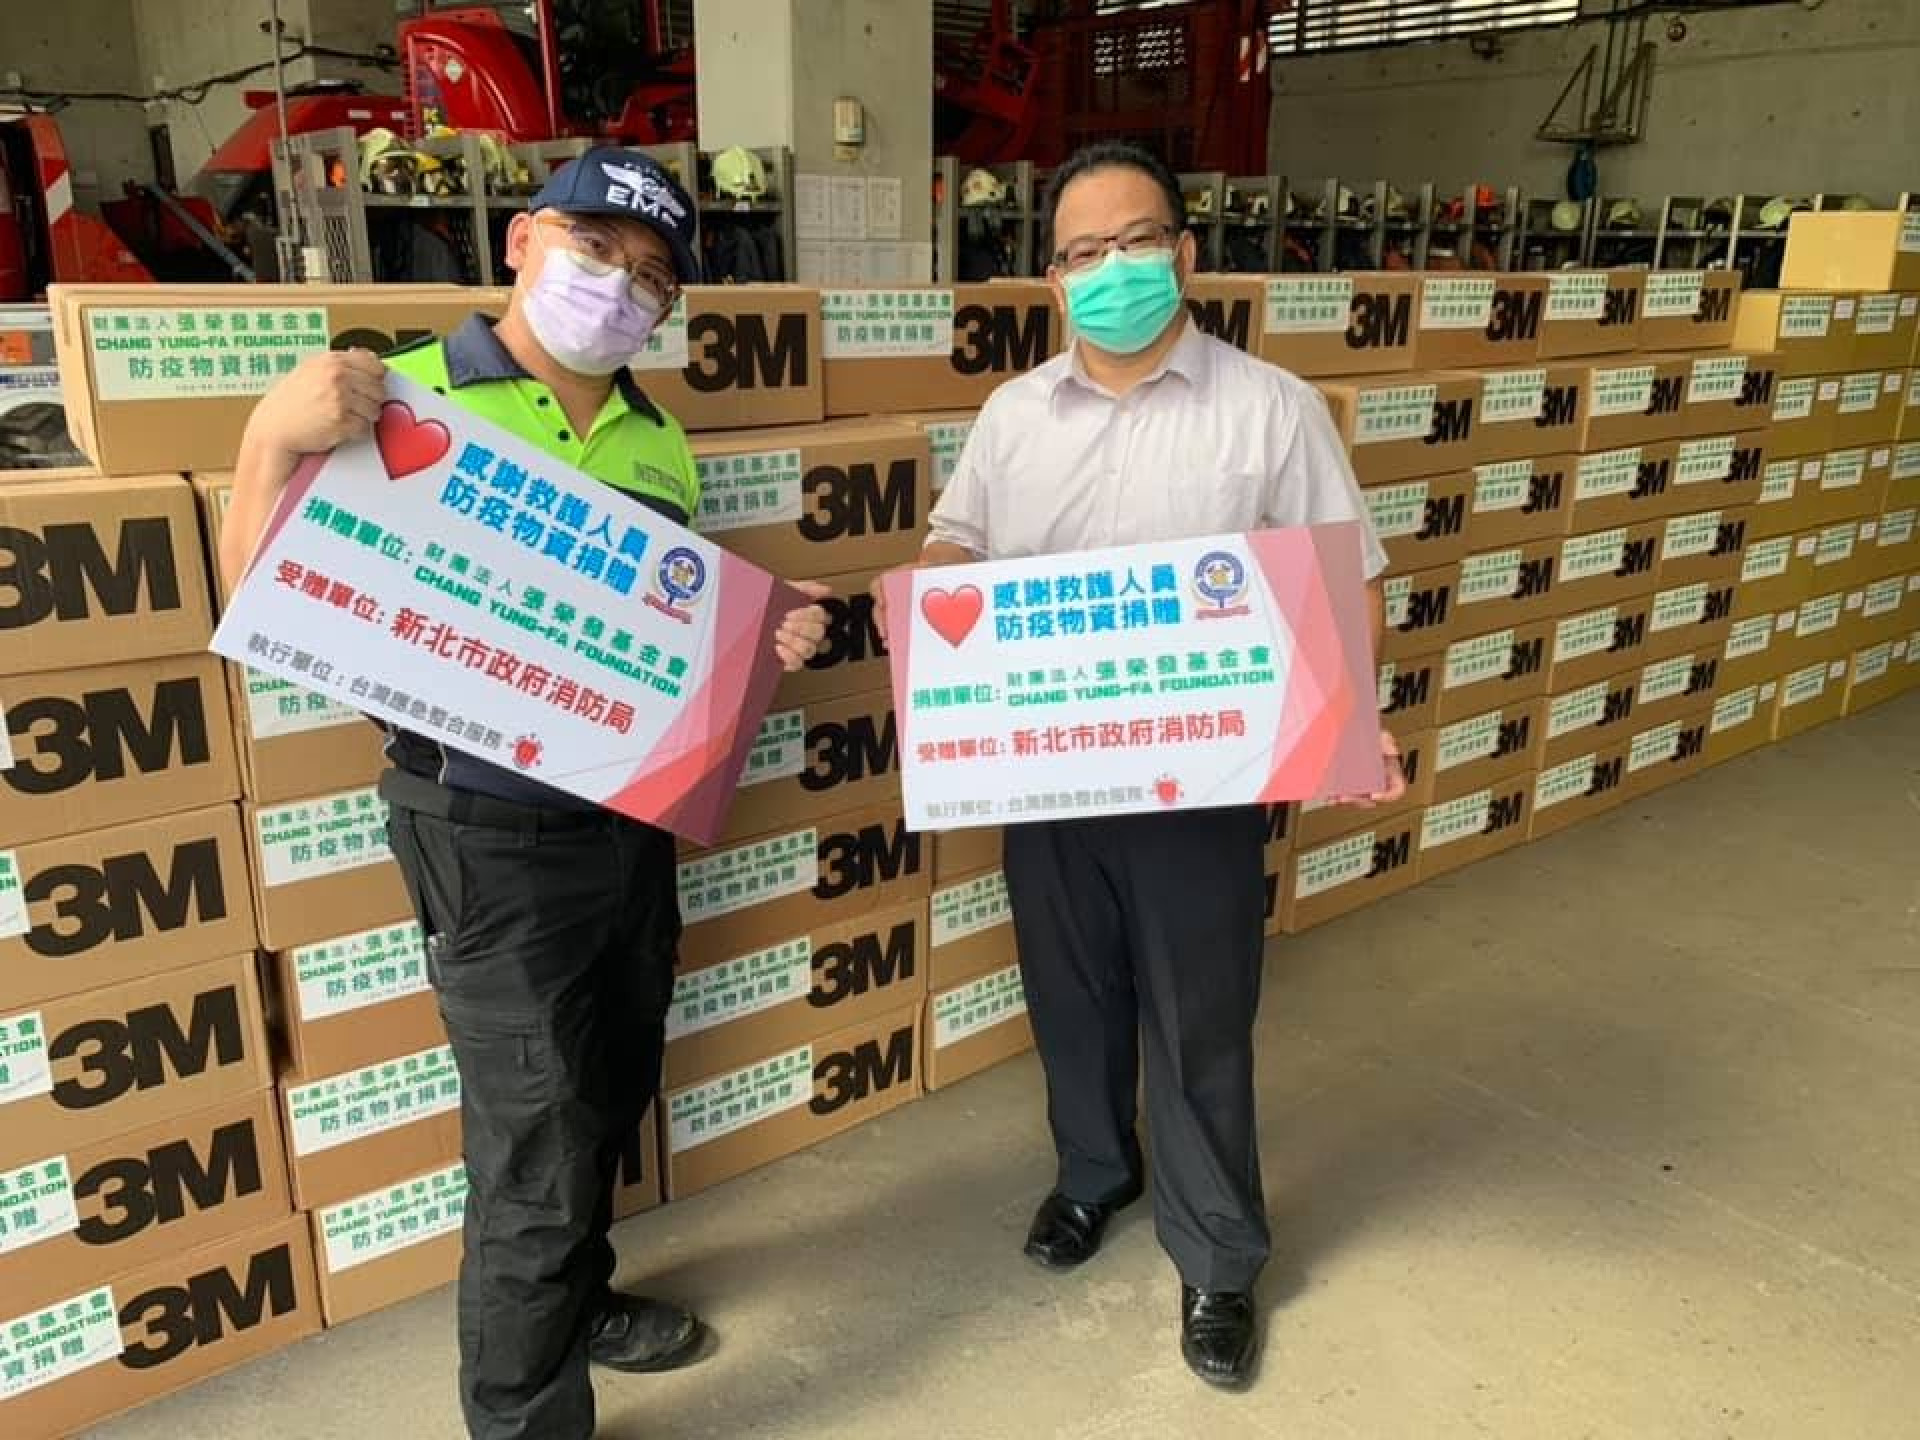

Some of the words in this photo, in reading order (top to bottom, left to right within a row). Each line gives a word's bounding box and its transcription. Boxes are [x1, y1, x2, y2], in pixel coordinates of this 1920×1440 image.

[1345, 293, 1411, 348] 3M
[1486, 290, 1543, 342] 3M
[1597, 288, 1637, 326] 3M
[1693, 288, 1732, 323] 3M
[95, 337, 152, 350] CHANG
[159, 336, 228, 348] YUNG-FA
[233, 334, 327, 347] FOUNDATION
[683, 314, 808, 392] 3M
[951, 305, 1049, 374] 3M
[1535, 386, 1578, 427] 3M
[1644, 376, 1684, 415] 3M
[1734, 370, 1774, 406] 3M
[1424, 399, 1473, 445] 3M
[799, 460, 916, 542] 3M
[1521, 472, 1563, 514] 3M
[1629, 459, 1670, 498] 3M
[456, 442, 649, 563] 感謝救護人員
[1415, 494, 1466, 540] 3M
[440, 475, 637, 596] 防疫物資捐贈
[1614, 538, 1655, 577] 3M
[0, 517, 180, 630] 3M
[993, 563, 1177, 609] 感謝救護人員
[1512, 557, 1552, 599] 3M
[414, 565, 482, 606] CHANG
[489, 598, 569, 647] YUNG-FA
[574, 639, 681, 698] FOUNDATION
[425, 542, 688, 678] 財團法人張榮發基金會
[995, 597, 1181, 642] 防疫物資捐贈
[1397, 586, 1449, 631] 3M
[390, 606, 637, 735] 新北市政府消防局
[1007, 645, 1270, 687] 財團法人張榮發基金會
[1501, 638, 1544, 680] 3M
[1007, 689, 1067, 706] CHANG
[1073, 682, 1151, 701] YUNG-FA
[1159, 669, 1274, 692] FOUNDATION
[2, 677, 209, 795] 3M
[800, 711, 899, 791] 3M
[1012, 709, 1246, 756] 新北市政府消防局
[1480, 791, 1523, 834] 3M
[813, 818, 920, 899] 3M
[1365, 833, 1411, 878] 3M
[23, 837, 226, 957] 3M
[808, 921, 915, 1008] 3M
[49, 985, 244, 1110] 3M
[809, 1026, 912, 1115] 3M
[74, 1118, 262, 1245] 3M
[117, 1243, 297, 1369] 3M
